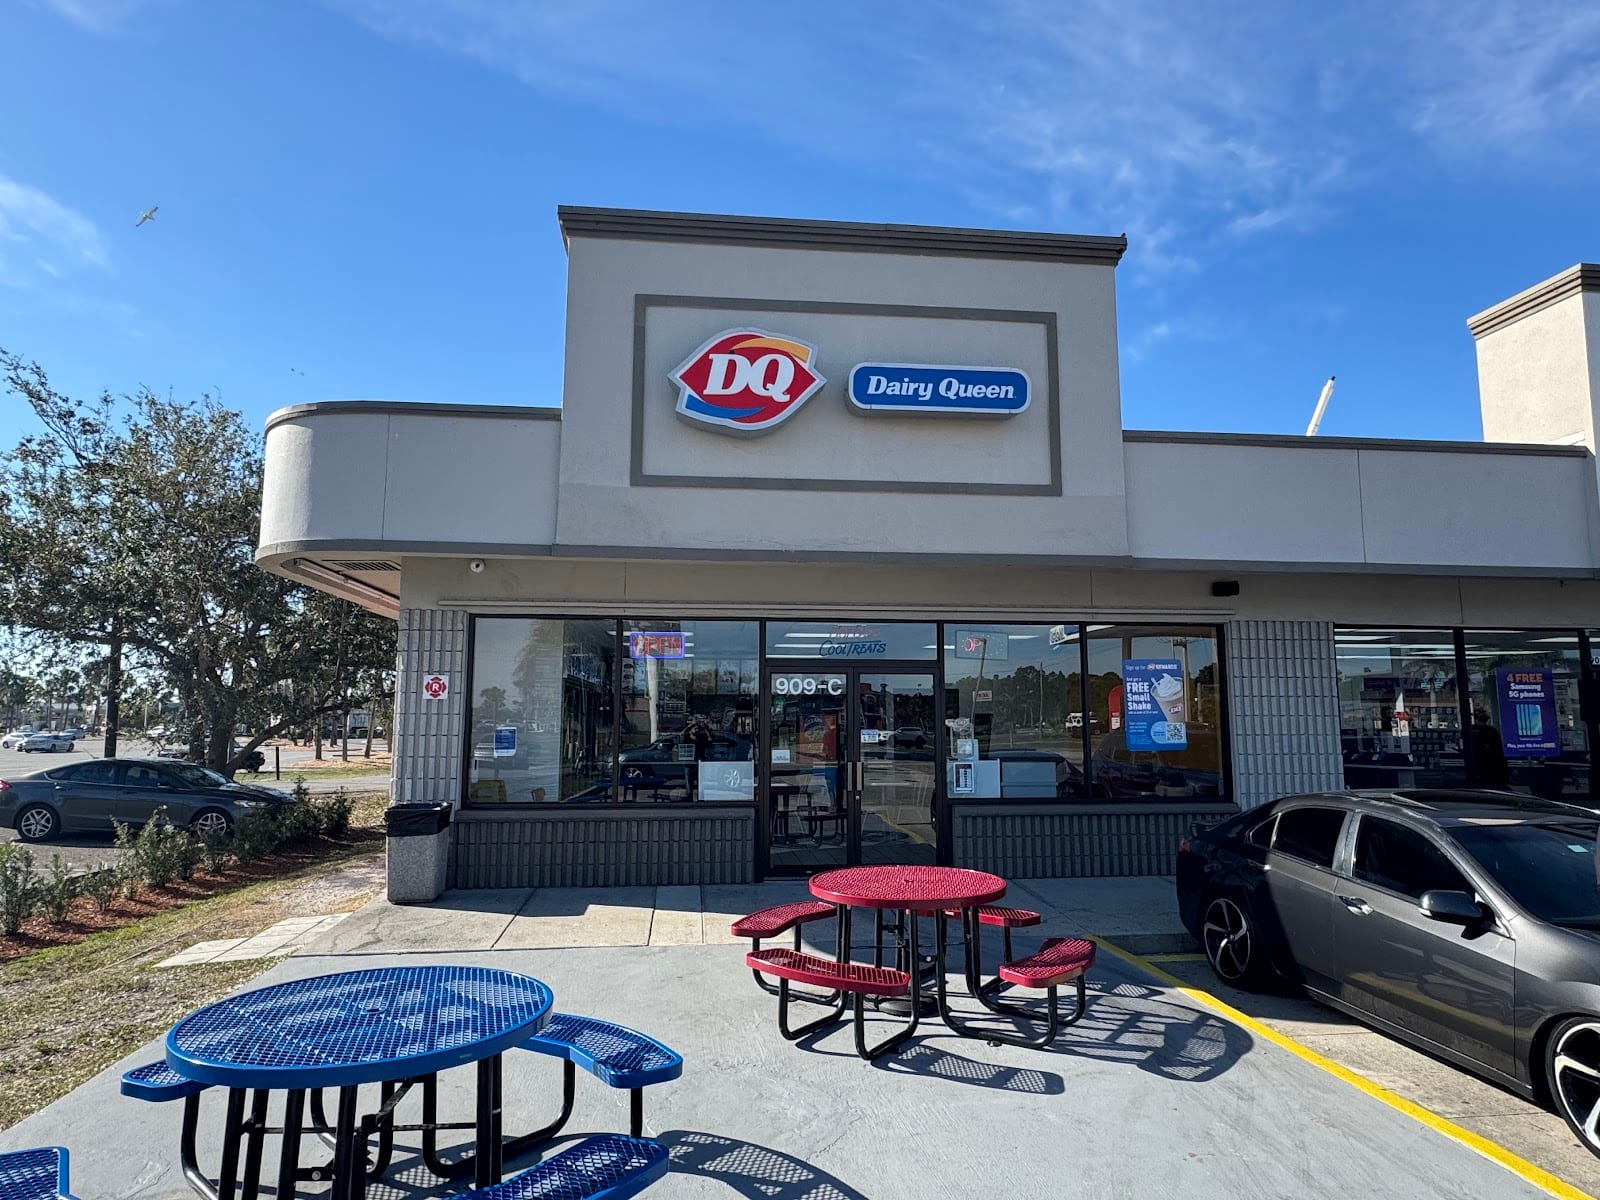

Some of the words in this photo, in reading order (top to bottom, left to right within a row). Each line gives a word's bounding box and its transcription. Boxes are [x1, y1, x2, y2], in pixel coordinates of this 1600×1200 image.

[703, 353, 795, 402] DQ
[867, 375, 933, 400] Dairy
[938, 377, 1015, 399] Queen
[633, 636, 683, 656] OPEN
[1507, 673, 1514, 682] 4
[1515, 673, 1543, 682] FREE
[432, 683, 440, 691] R
[776, 678, 842, 695] 909-C
[1126, 682, 1150, 692] FREE
[1510, 683, 1542, 691] Samsung
[1127, 693, 1151, 701] Small
[1520, 690, 1545, 699] phones
[1127, 702, 1151, 710] Shake
